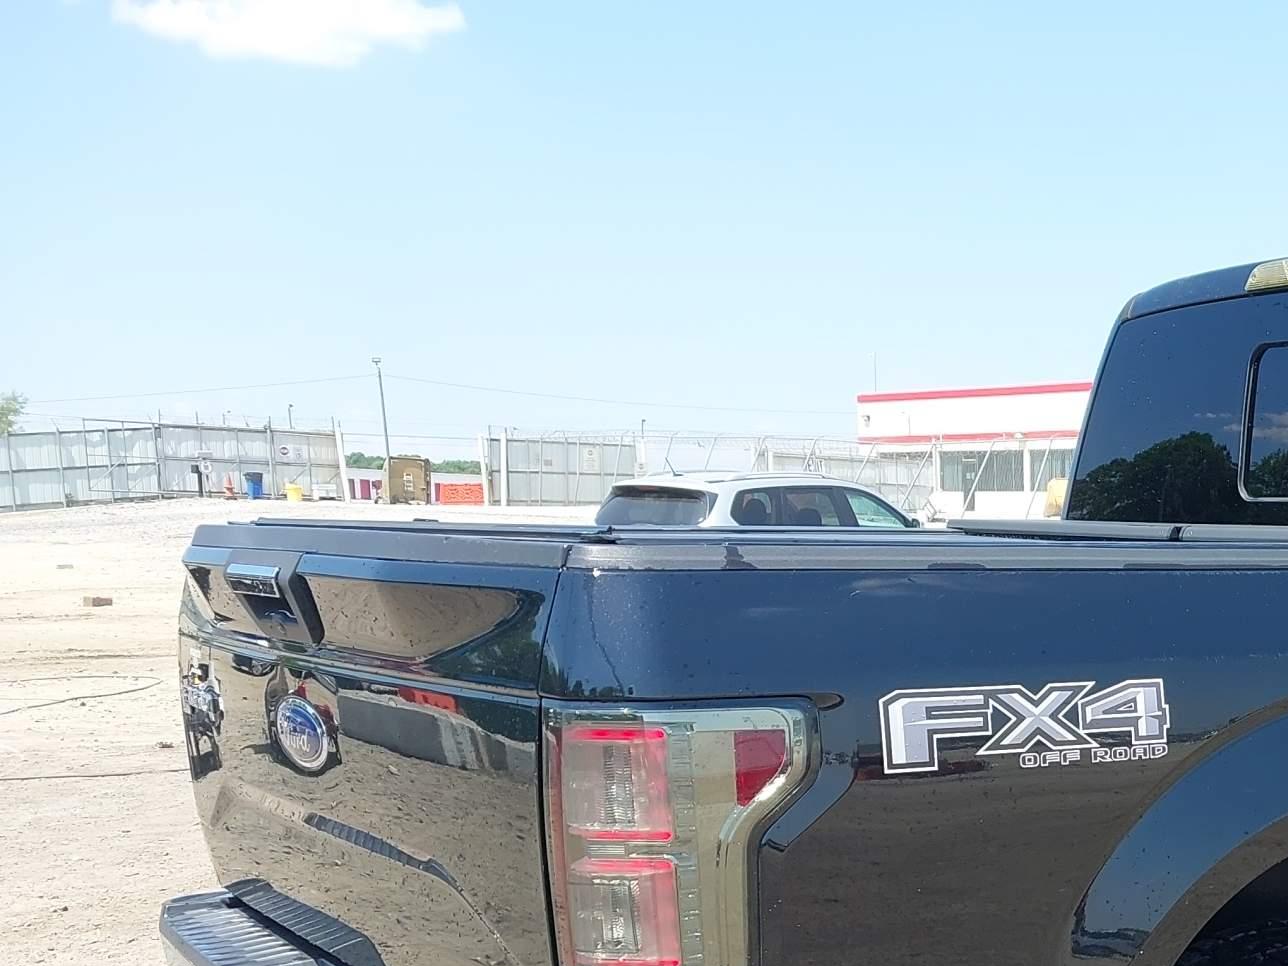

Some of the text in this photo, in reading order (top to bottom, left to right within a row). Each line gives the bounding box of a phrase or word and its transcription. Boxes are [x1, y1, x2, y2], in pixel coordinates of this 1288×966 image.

[879, 678, 1170, 774] FX4
[1019, 744, 1168, 768] OFF ROAD
